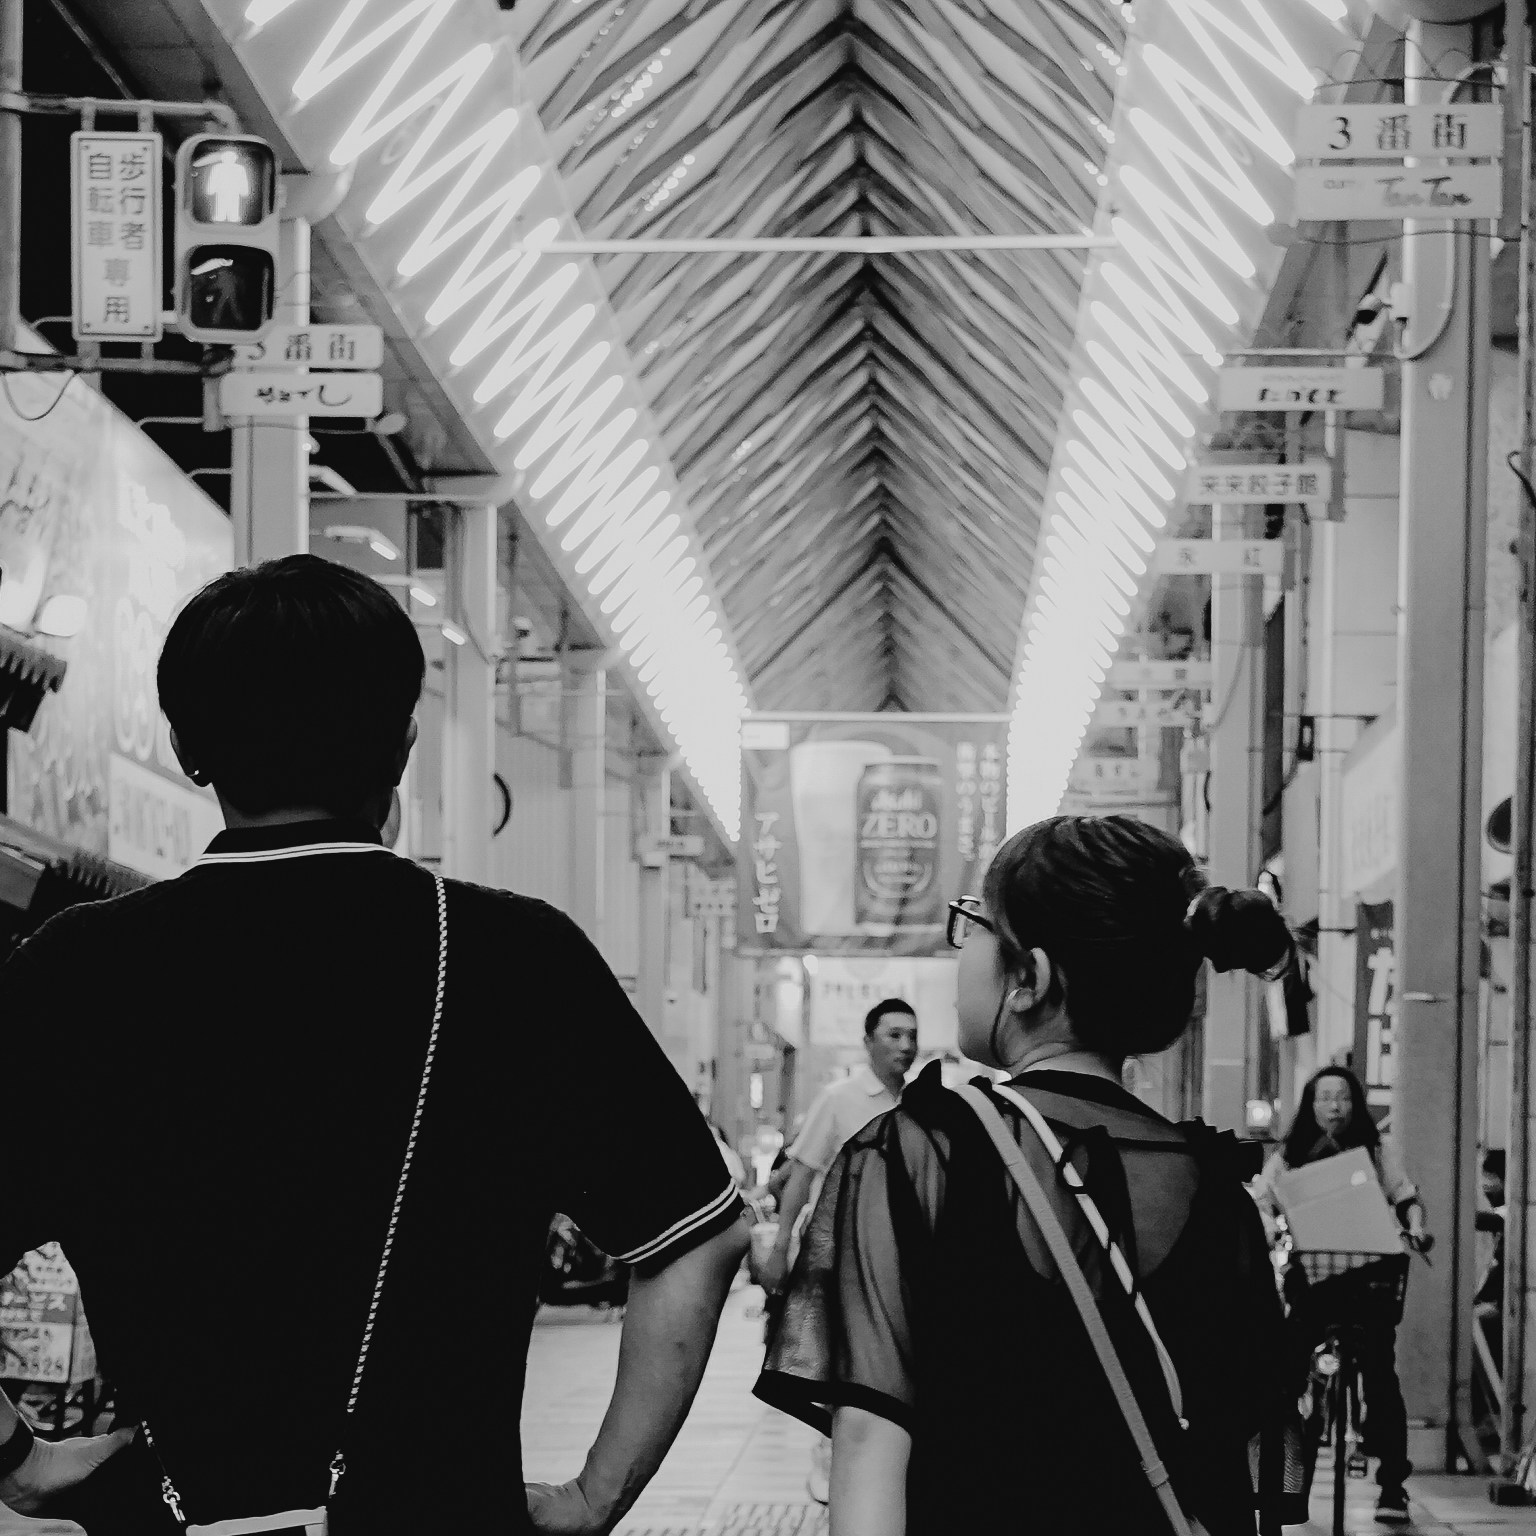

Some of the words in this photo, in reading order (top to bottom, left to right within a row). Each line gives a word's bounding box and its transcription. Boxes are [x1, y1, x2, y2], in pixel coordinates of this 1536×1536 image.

[1328, 114, 1468, 150] 3番街
[87, 152, 114, 248] 自転車
[120, 152, 146, 250] 歩行者
[104, 258, 130, 324] 専用
[862, 812, 937, 838] ZERO
[752, 811, 783, 934] アサヒゼロ
